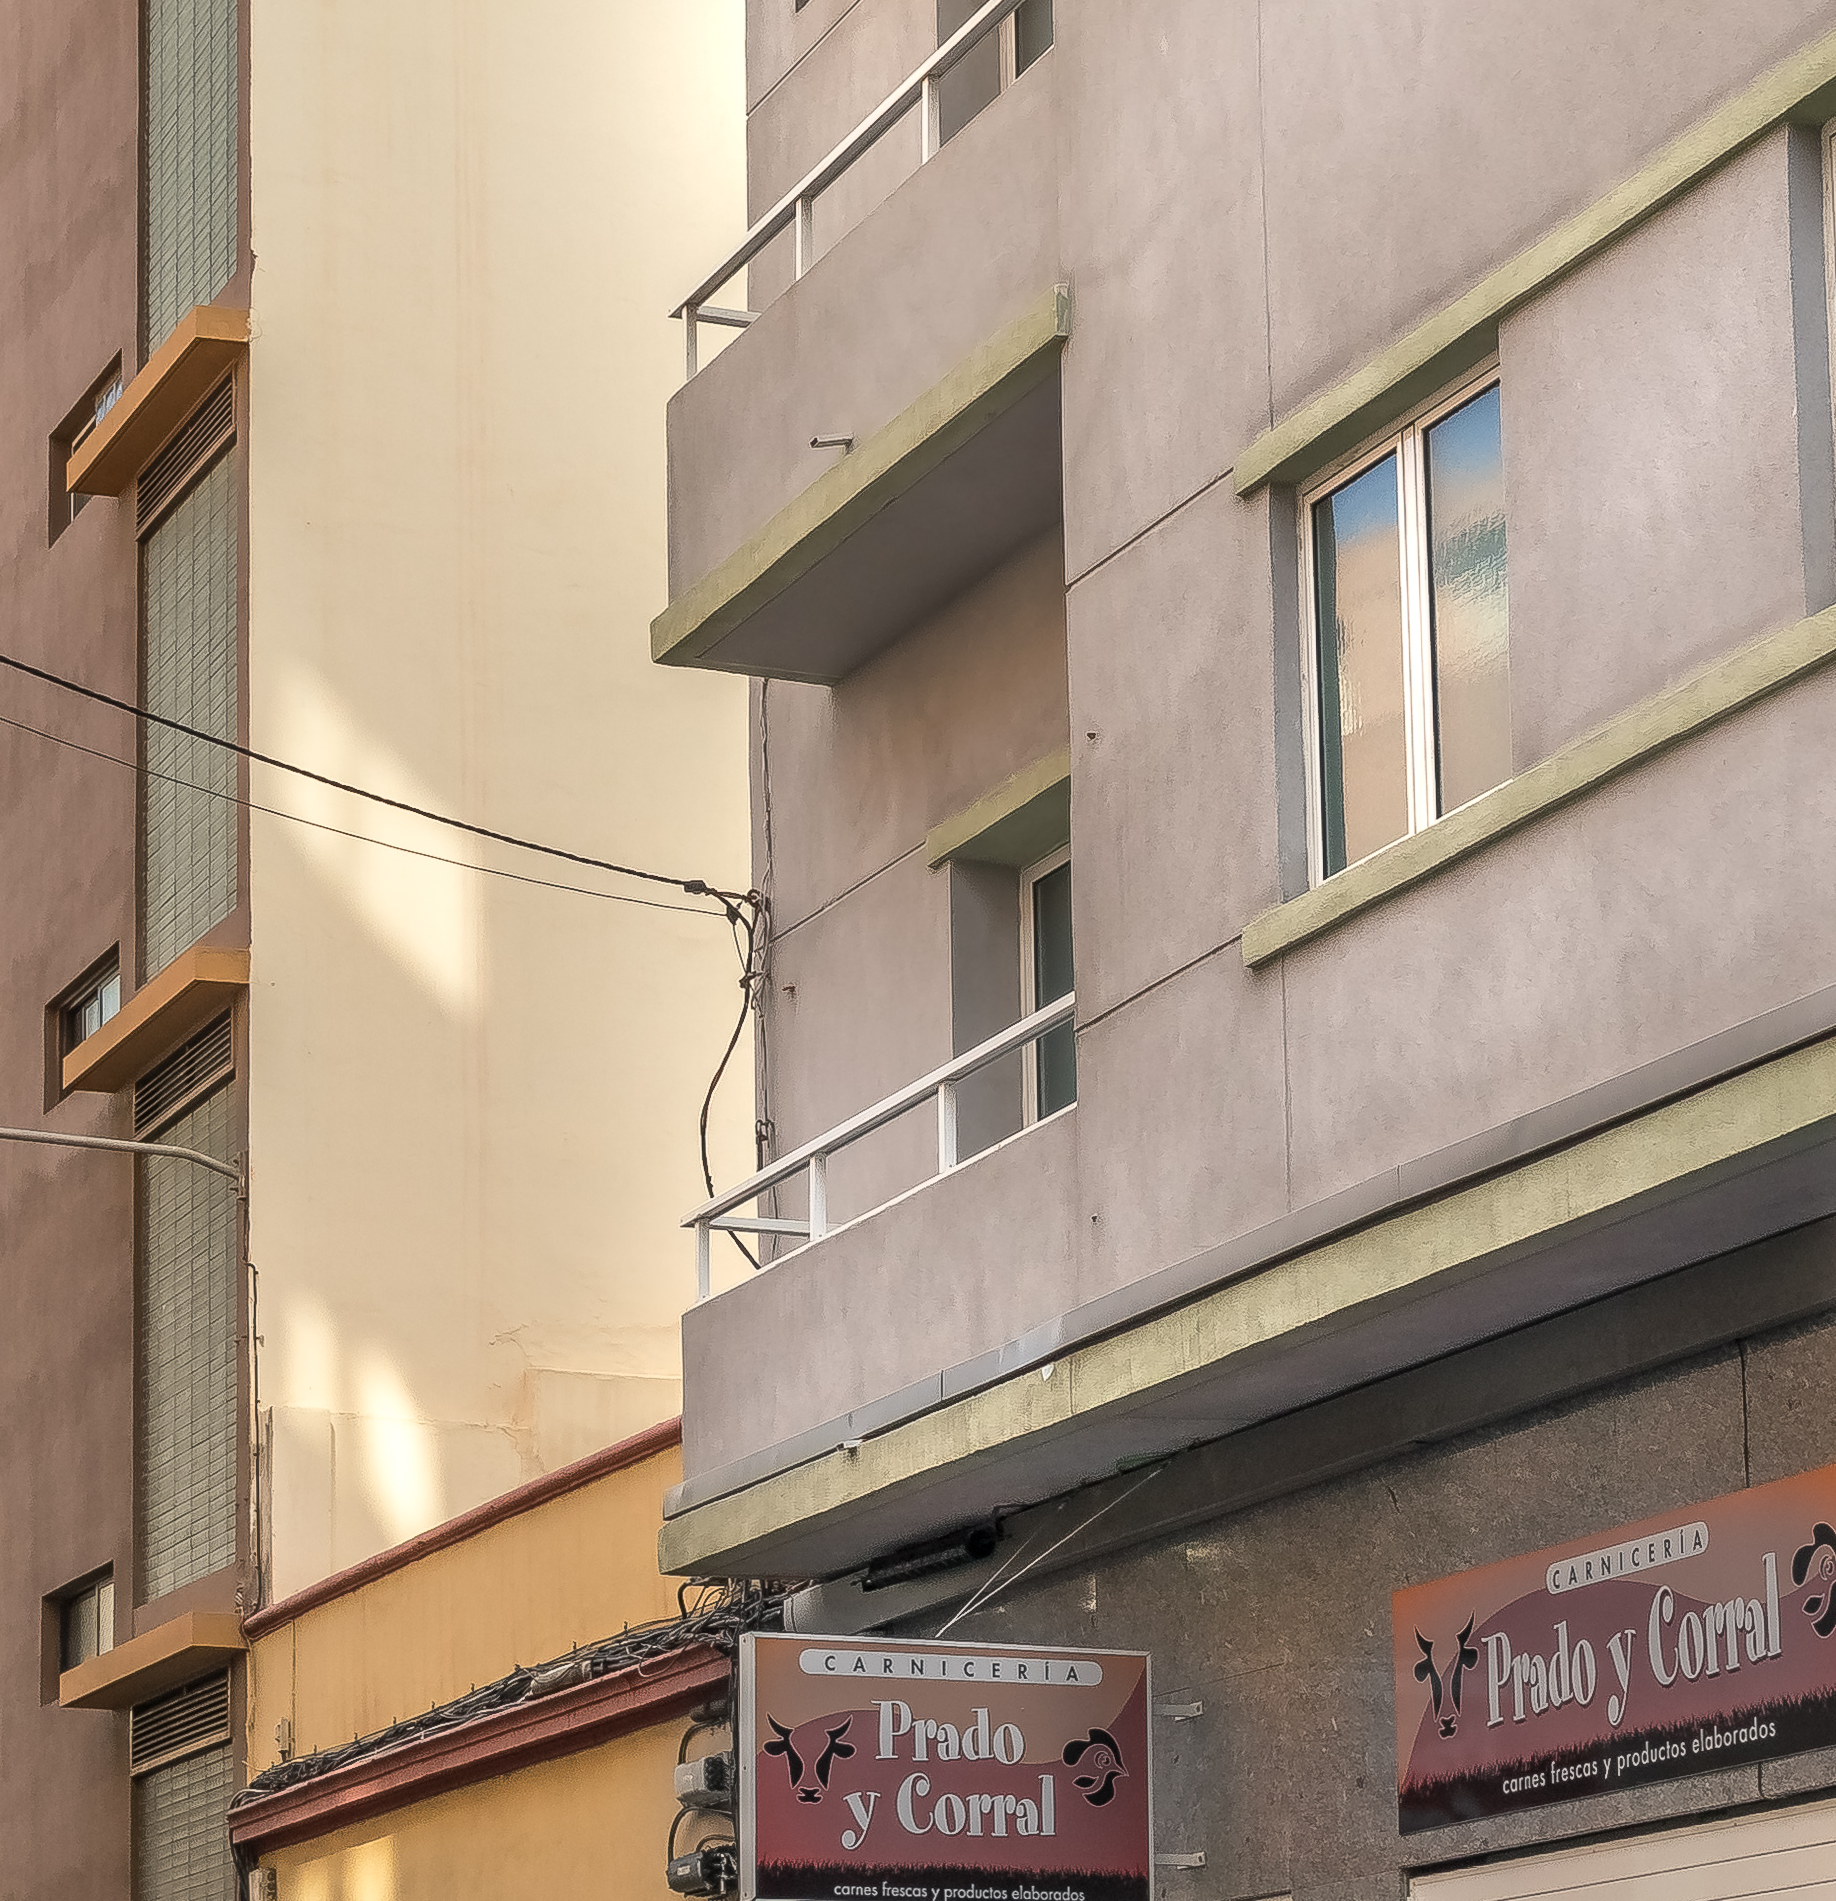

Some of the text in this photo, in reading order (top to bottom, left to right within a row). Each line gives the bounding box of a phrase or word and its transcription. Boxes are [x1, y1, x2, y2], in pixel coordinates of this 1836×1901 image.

[1552, 1529, 1703, 1589] CARNICERÍA
[824, 1655, 1080, 1682] CARNICERÍA
[1481, 1552, 1782, 1727] Prado y Corral
[870, 1699, 1025, 1766] Prado
[1502, 1716, 1777, 1794] carnes frescas y productos elaborados
[840, 1772, 1057, 1850] y Corral
[833, 1881, 1086, 1901] carnes frescas y productos elaborados
